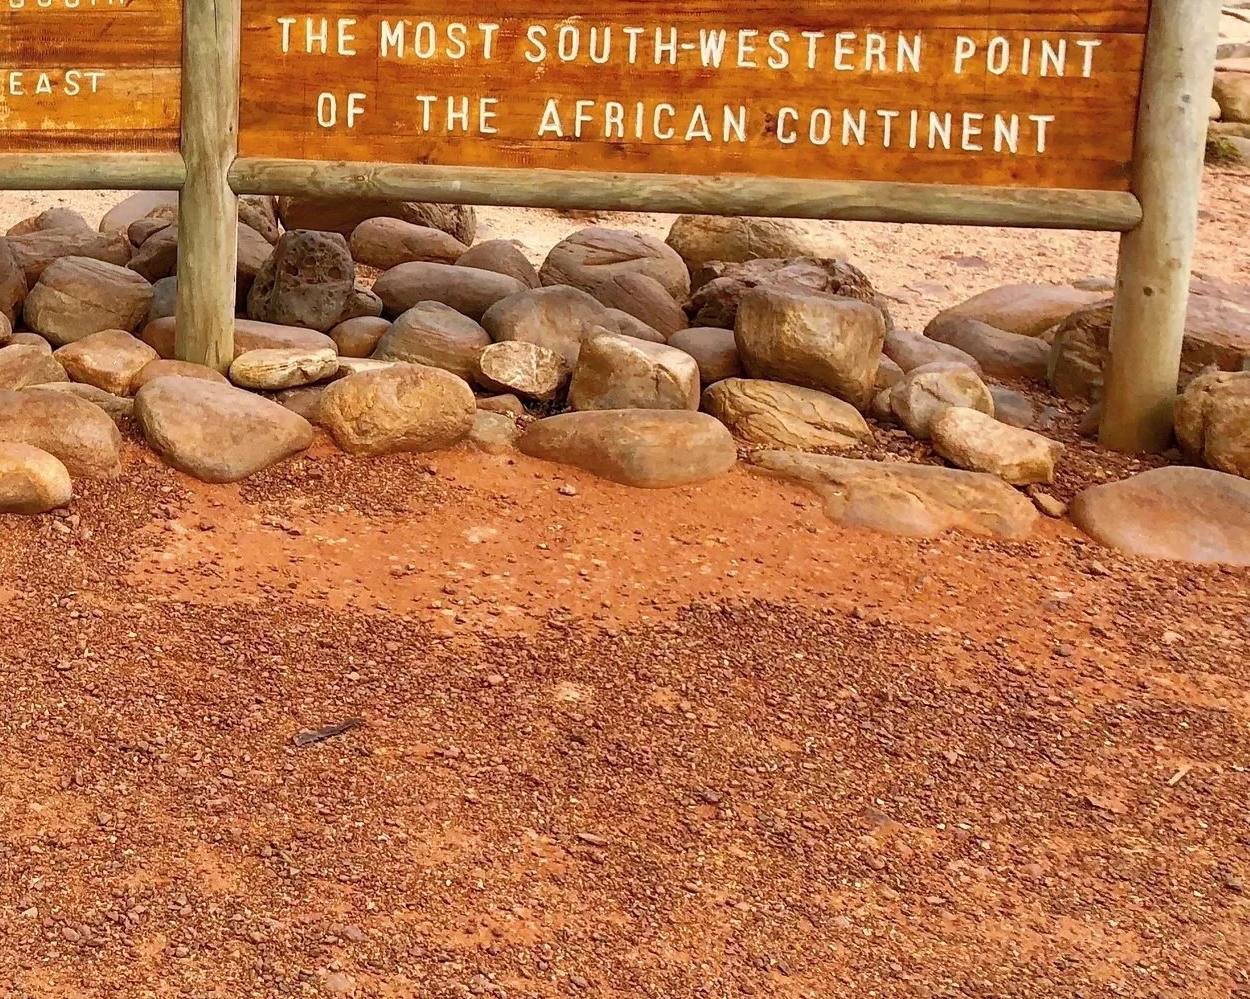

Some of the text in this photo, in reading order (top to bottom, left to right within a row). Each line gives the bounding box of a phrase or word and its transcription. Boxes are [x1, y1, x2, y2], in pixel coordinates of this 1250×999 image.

[277, 18, 1102, 78] THE MOST SOUTH-WESTERN POINT
[9, 70, 107, 96] EAST
[317, 92, 1056, 154] OF THE AFRICAN CONTINENT
